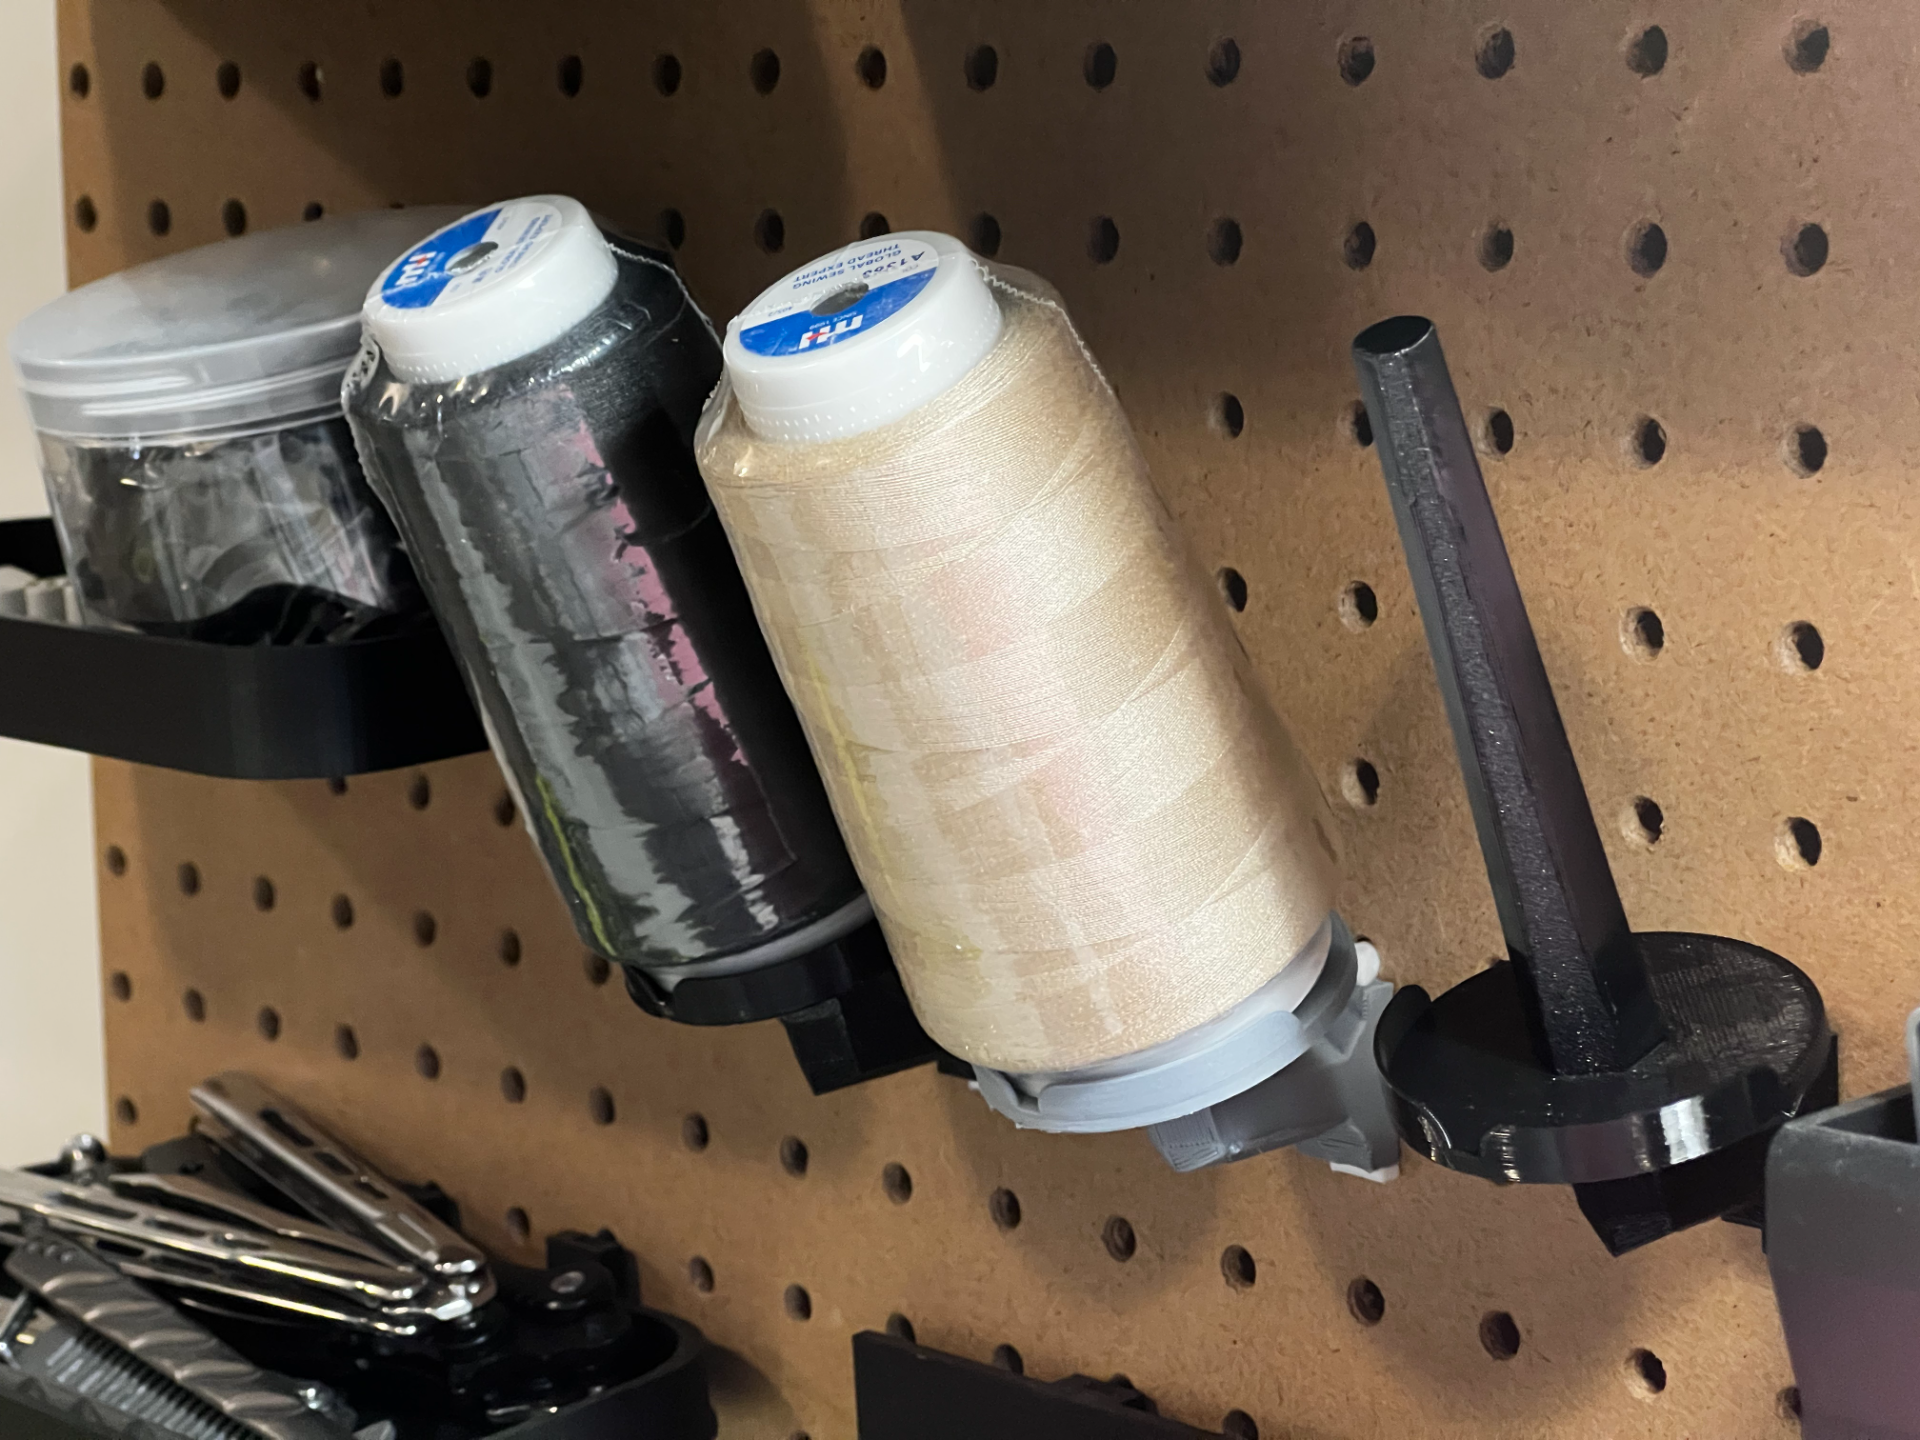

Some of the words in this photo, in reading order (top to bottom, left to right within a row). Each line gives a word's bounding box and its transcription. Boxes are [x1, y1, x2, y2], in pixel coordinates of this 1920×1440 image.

[847, 243, 900, 265] THREAD
[850, 250, 902, 271] GLOBAL
[792, 268, 845, 289] SEWING
[794, 262, 844, 283] EXPERT
[833, 311, 858, 322] SINCE
